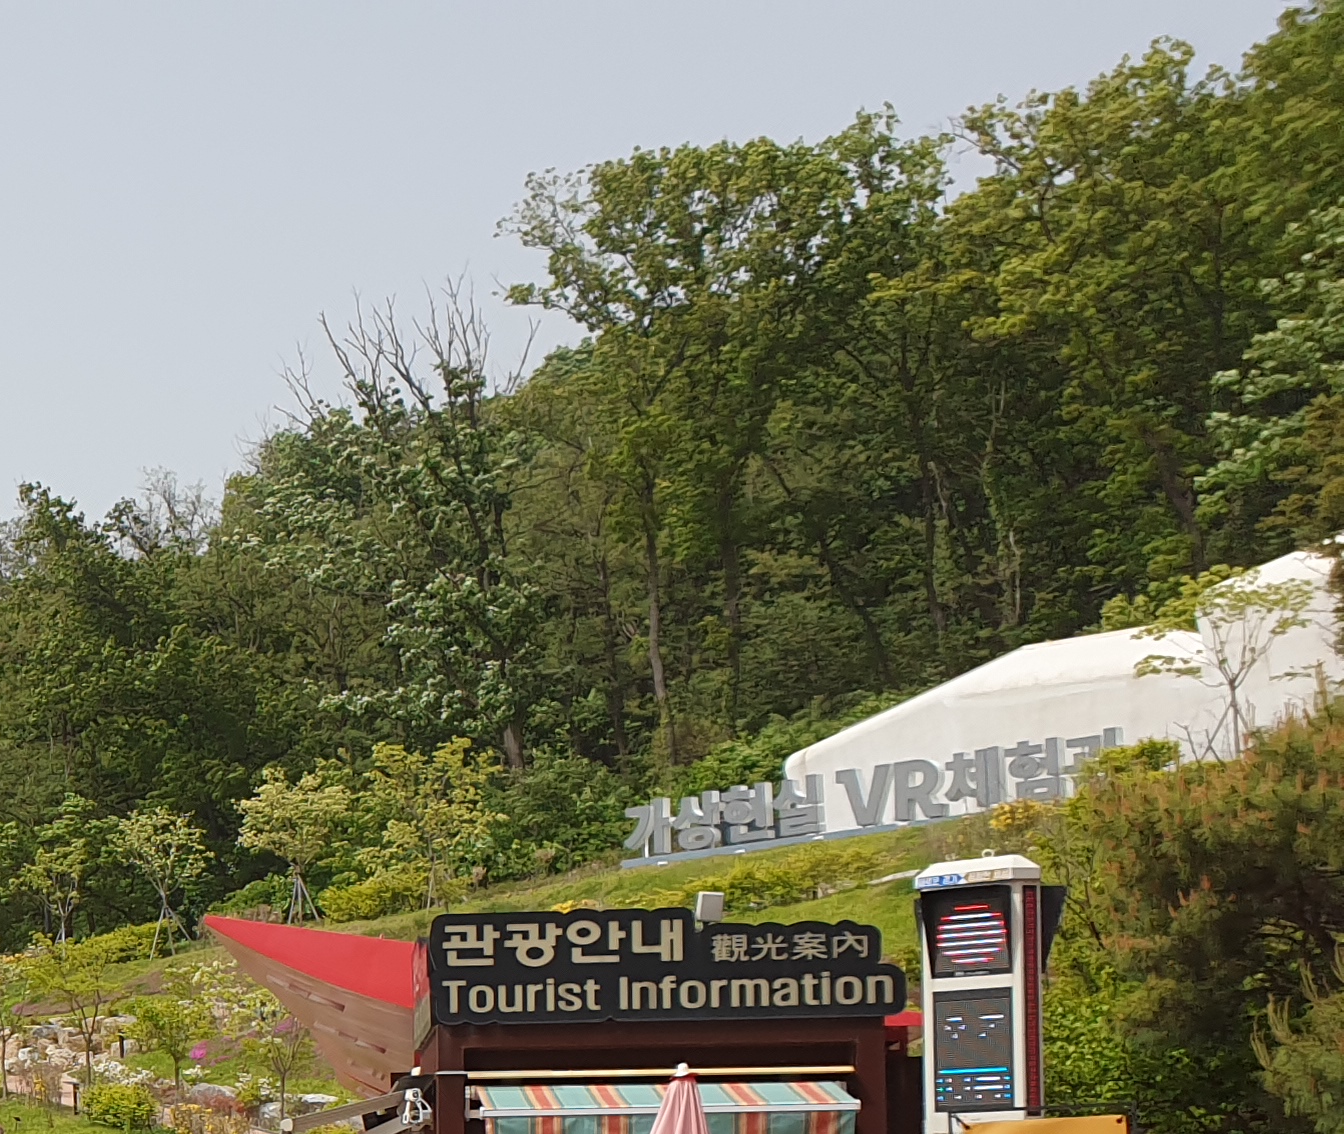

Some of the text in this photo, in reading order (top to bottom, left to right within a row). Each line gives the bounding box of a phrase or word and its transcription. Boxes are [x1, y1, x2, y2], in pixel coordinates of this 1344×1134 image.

[623, 773, 827, 854] 가상현실
[442, 918, 683, 967] 관광안내
[712, 931, 869, 963] 觀光案內
[442, 971, 894, 1014] Tourist Information
